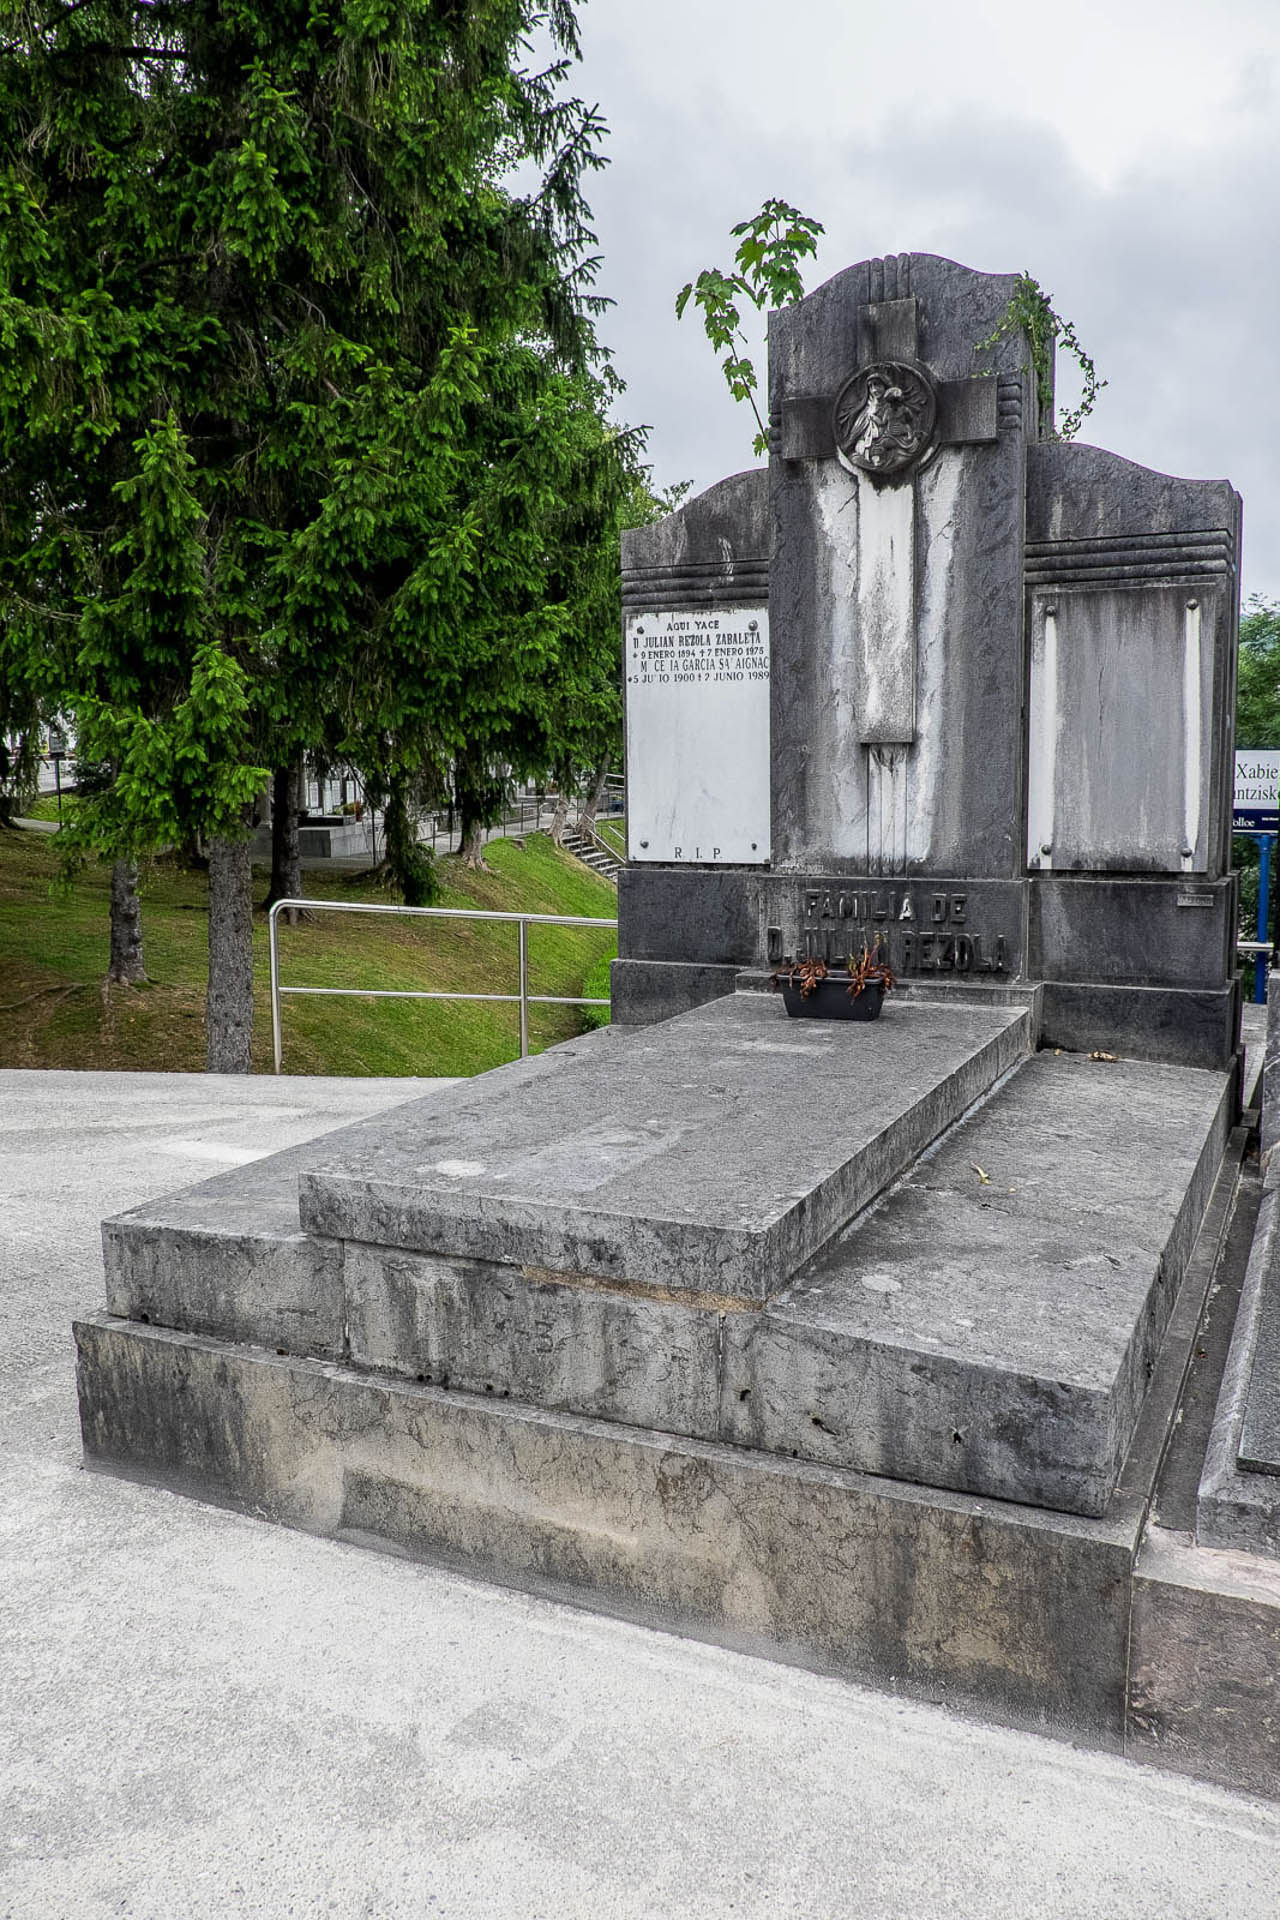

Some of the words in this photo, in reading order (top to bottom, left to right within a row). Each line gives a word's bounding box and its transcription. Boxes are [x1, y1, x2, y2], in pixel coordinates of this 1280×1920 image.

[667, 622, 690, 632] AQUI
[694, 620, 720, 630] YACE
[643, 636, 675, 649] JULIAN
[678, 634, 711, 647] REZOLA
[715, 631, 761, 646] ZABALETA
[641, 650, 646, 660] 9
[648, 650, 675, 660] ENERO
[678, 649, 696, 659] 1894
[707, 648, 712, 657] 7
[715, 647, 744, 657] ENERO
[746, 646, 764, 656] 1975
[654, 659, 679, 672] CEIA
[682, 658, 716, 672] GARCIA
[633, 674, 639, 684] 5
[641, 673, 670, 684] JUIO
[674, 672, 696, 683] 1900
[713, 671, 744, 682] JUNIO
[748, 670, 769, 681] 1989
[1236, 763, 1279, 780] Xabie
[1234, 785, 1279, 801] ntzisk
[1233, 817, 1255, 828] olloe
[805, 889, 916, 921] FAMILIA
[931, 893, 968, 923] DE
[901, 930, 1010, 973] REZOLA
